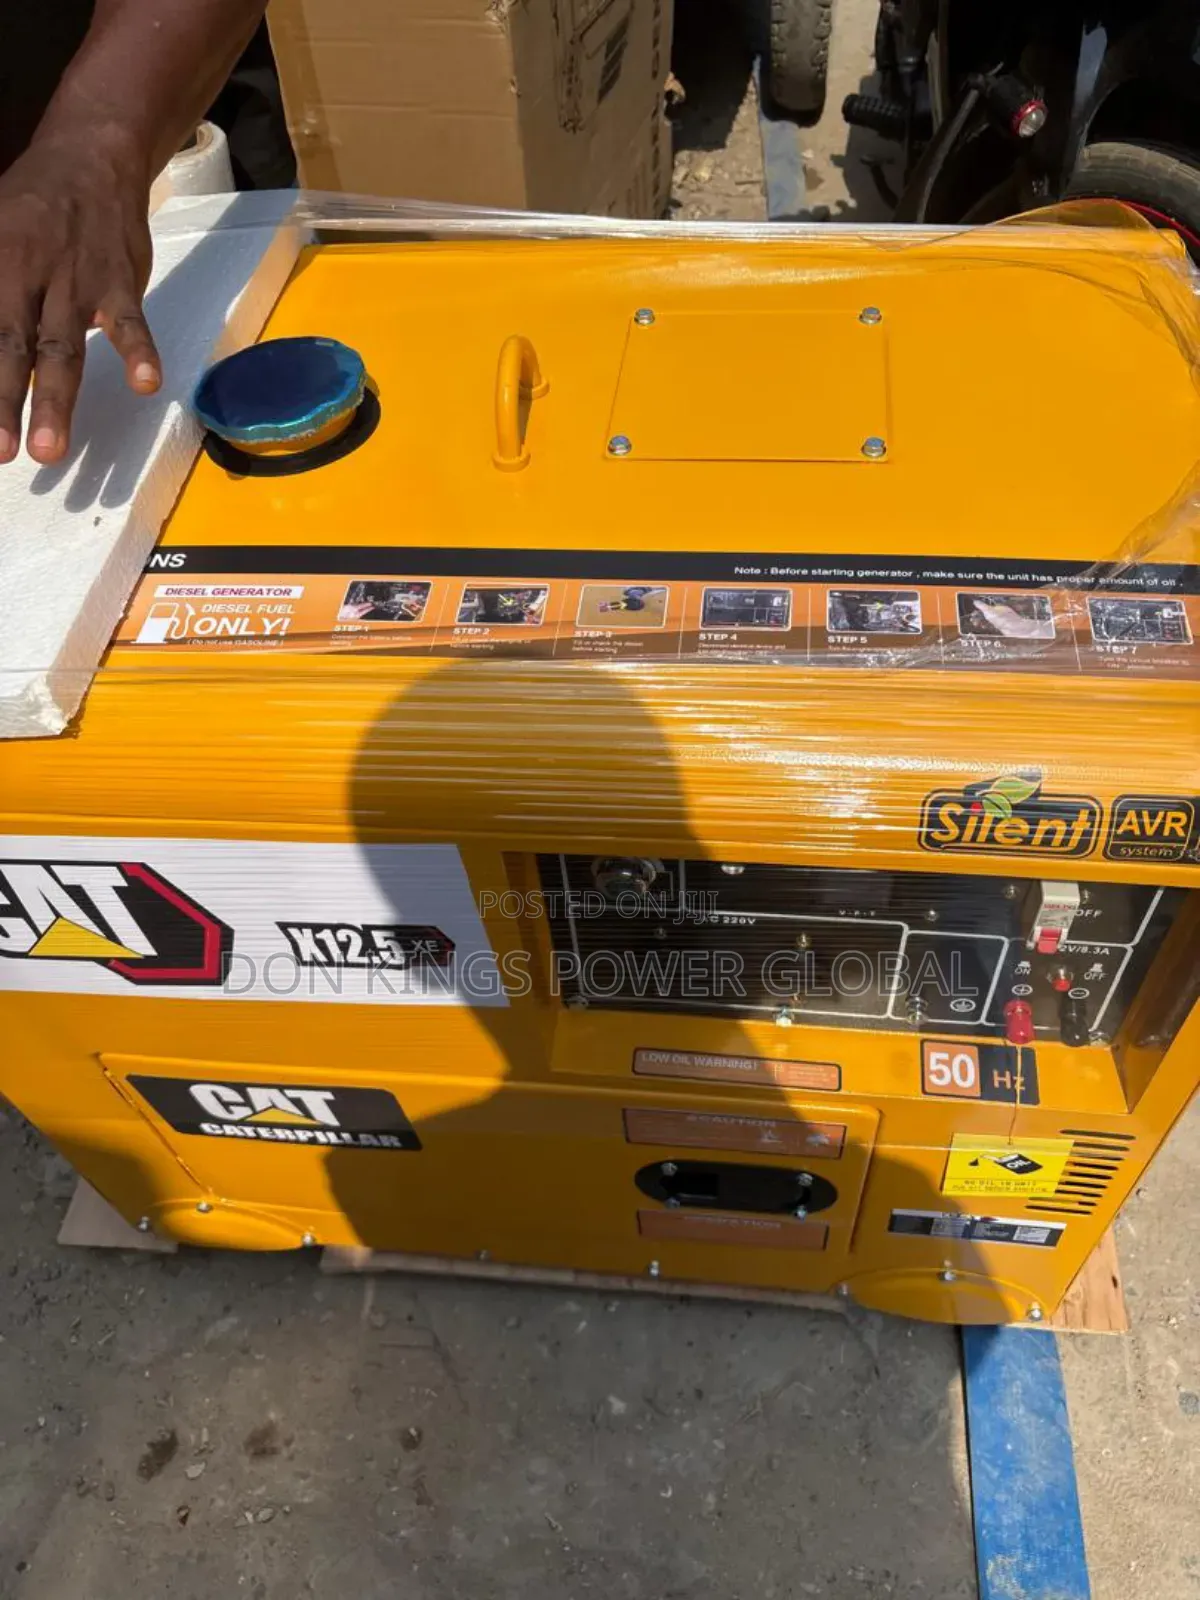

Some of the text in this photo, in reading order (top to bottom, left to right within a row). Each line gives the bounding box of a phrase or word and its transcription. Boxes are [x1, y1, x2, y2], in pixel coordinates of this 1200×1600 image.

[734, 566, 761, 575] Note
[770, 566, 808, 576] Before
[811, 567, 854, 577] starting
[857, 568, 913, 578] generator
[923, 570, 955, 578] make
[957, 571, 983, 580] sure
[986, 571, 1004, 580] the
[1008, 572, 1029, 581] unit
[1032, 573, 1053, 582] has
[1056, 574, 1095, 585] proper
[1146, 577, 1158, 586] of
[164, 587, 293, 597] DIESEL GENERATOR
[201, 603, 296, 614] DIESEL FUEL
[193, 617, 291, 636] ONLY!
[453, 627, 490, 635] STEP 2
[574, 630, 602, 638] STEP
[698, 633, 737, 641] STEP 4
[828, 636, 868, 644] STEP 5
[961, 640, 991, 648] STEP
[930, 802, 1092, 848] Silent
[1116, 809, 1188, 837] AVR
[1119, 847, 1174, 857] system
[1075, 909, 1103, 918] OFF
[722, 916, 756, 925] 220V
[285, 924, 405, 966] X12.5
[1059, 945, 1110, 955] 2V/8.3A
[1084, 972, 1107, 981] OFF
[642, 1053, 758, 1071] LOW OIL WARNING!
[928, 1051, 1027, 1091] 50 Hz
[188, 1083, 341, 1127] CAT
[199, 1122, 402, 1148] CATERPILLAR
[1006, 1158, 1031, 1169] OIL
